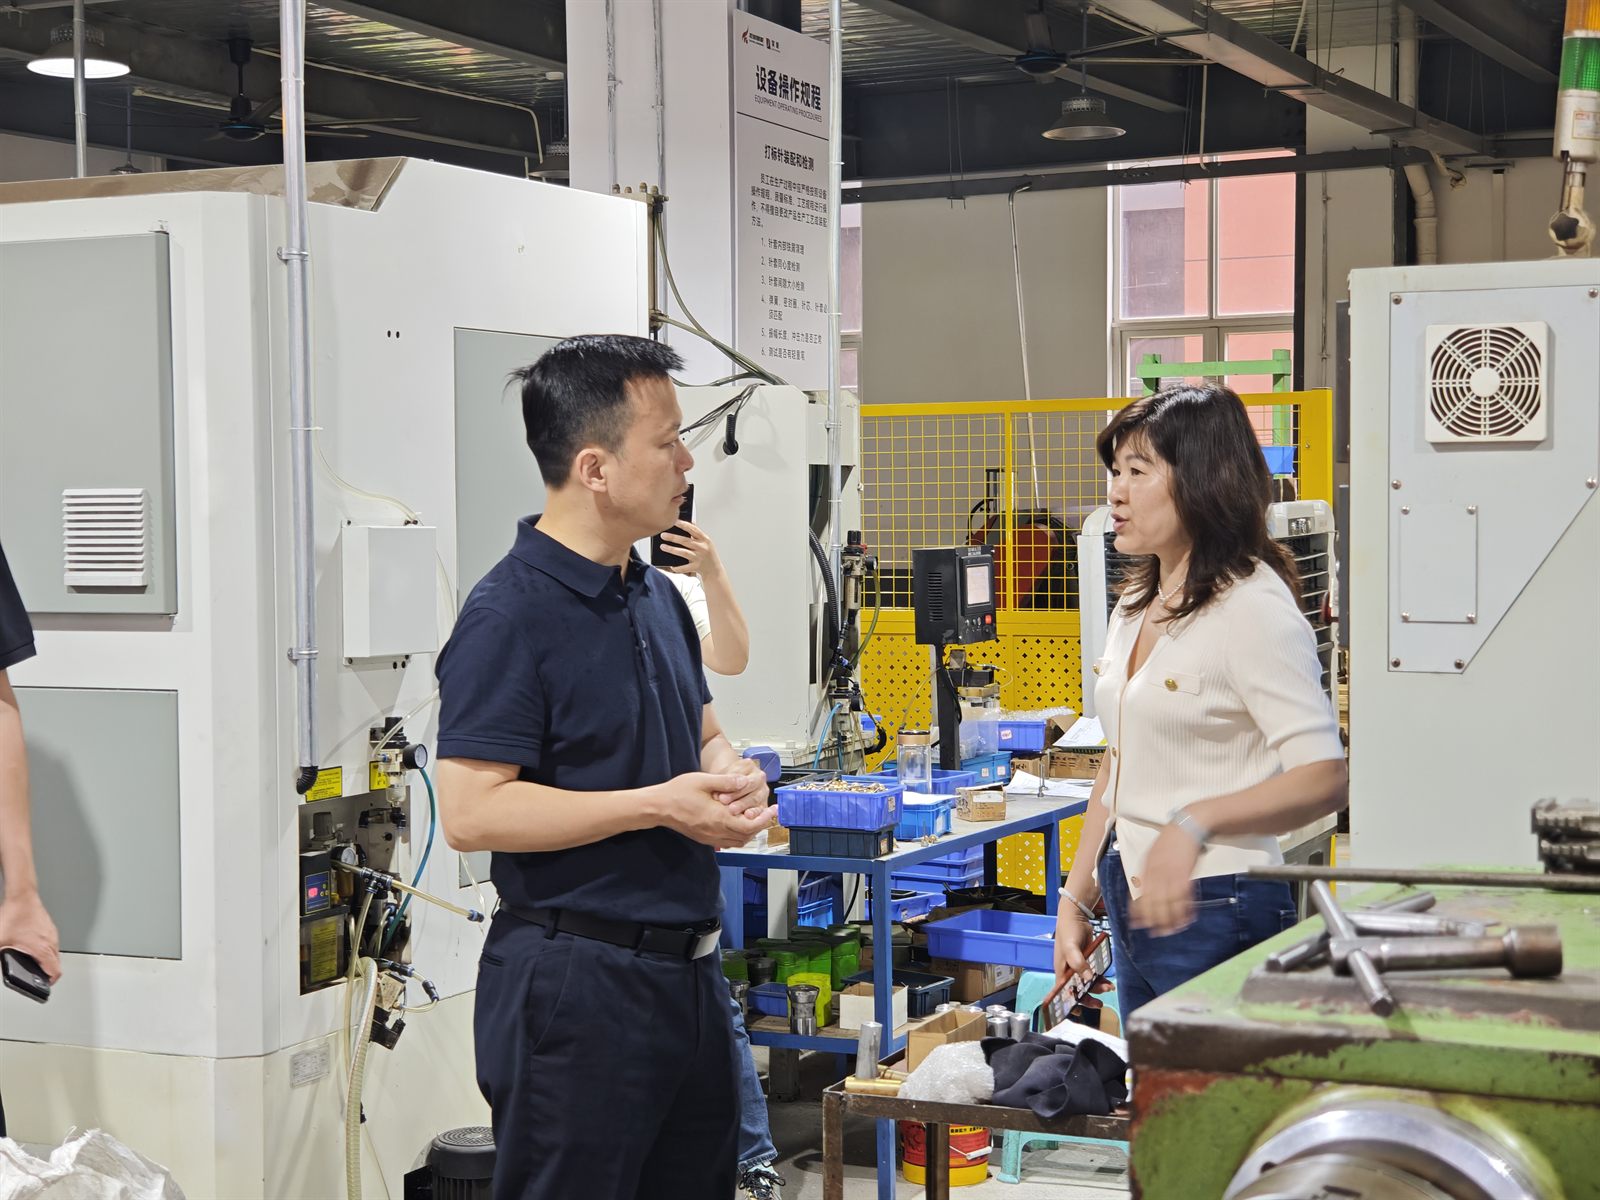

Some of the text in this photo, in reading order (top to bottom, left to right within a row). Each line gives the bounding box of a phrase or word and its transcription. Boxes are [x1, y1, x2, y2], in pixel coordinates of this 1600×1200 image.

[754, 94, 777, 107] EQUIPMENT
[755, 65, 822, 110] 设备操作规程
[764, 144, 814, 171] 打标针装配和检测
